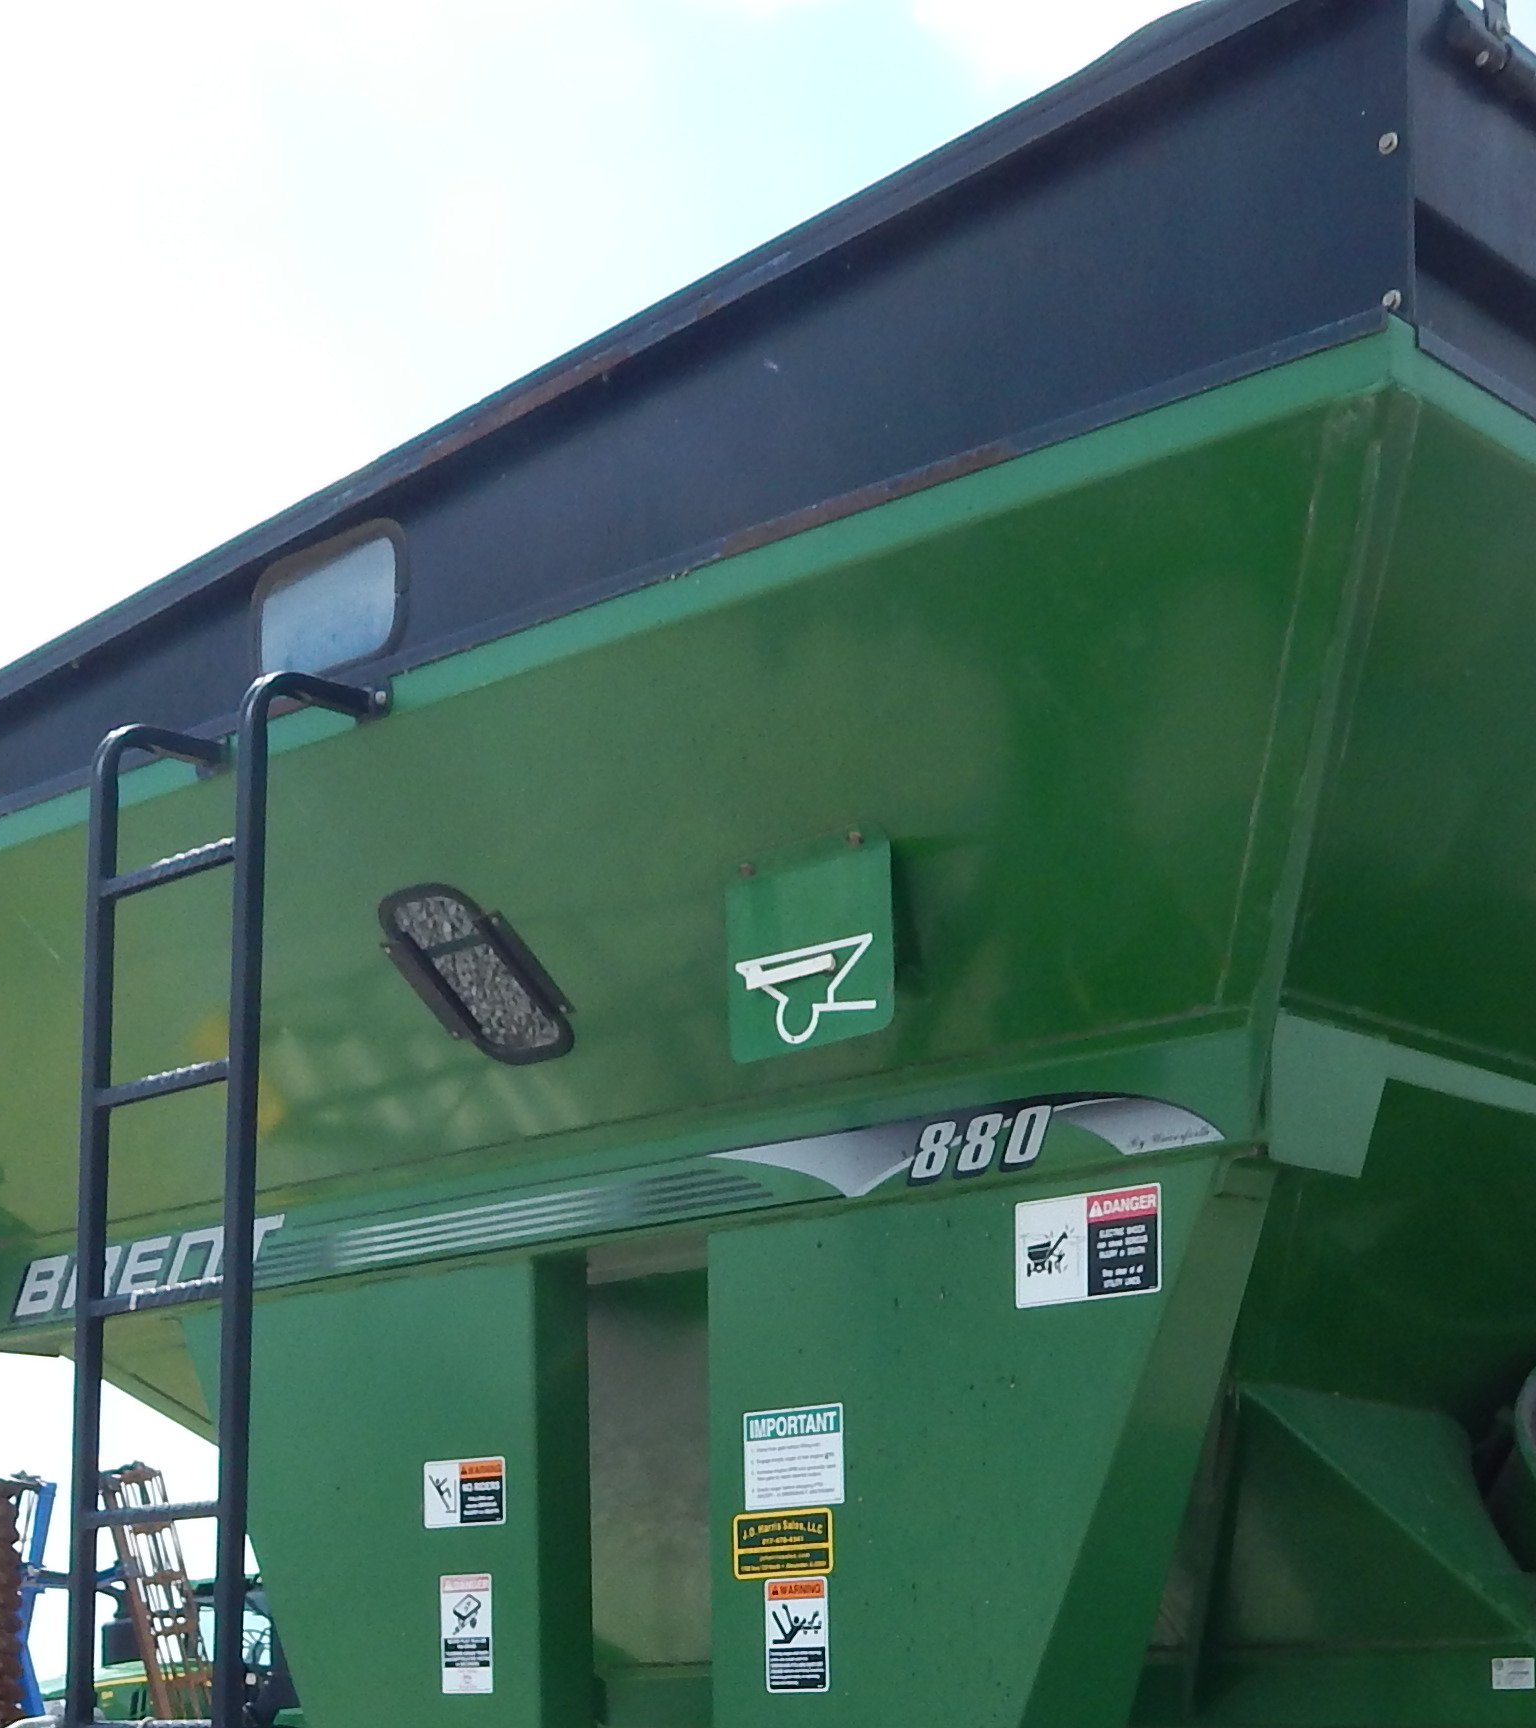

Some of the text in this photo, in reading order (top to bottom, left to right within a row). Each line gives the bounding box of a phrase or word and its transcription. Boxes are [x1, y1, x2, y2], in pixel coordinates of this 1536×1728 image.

[911, 1105, 1052, 1179] 880
[1103, 1194, 1156, 1214] DANGER
[749, 1411, 837, 1439] IMPORTANT
[780, 1583, 821, 1595] WARNING
